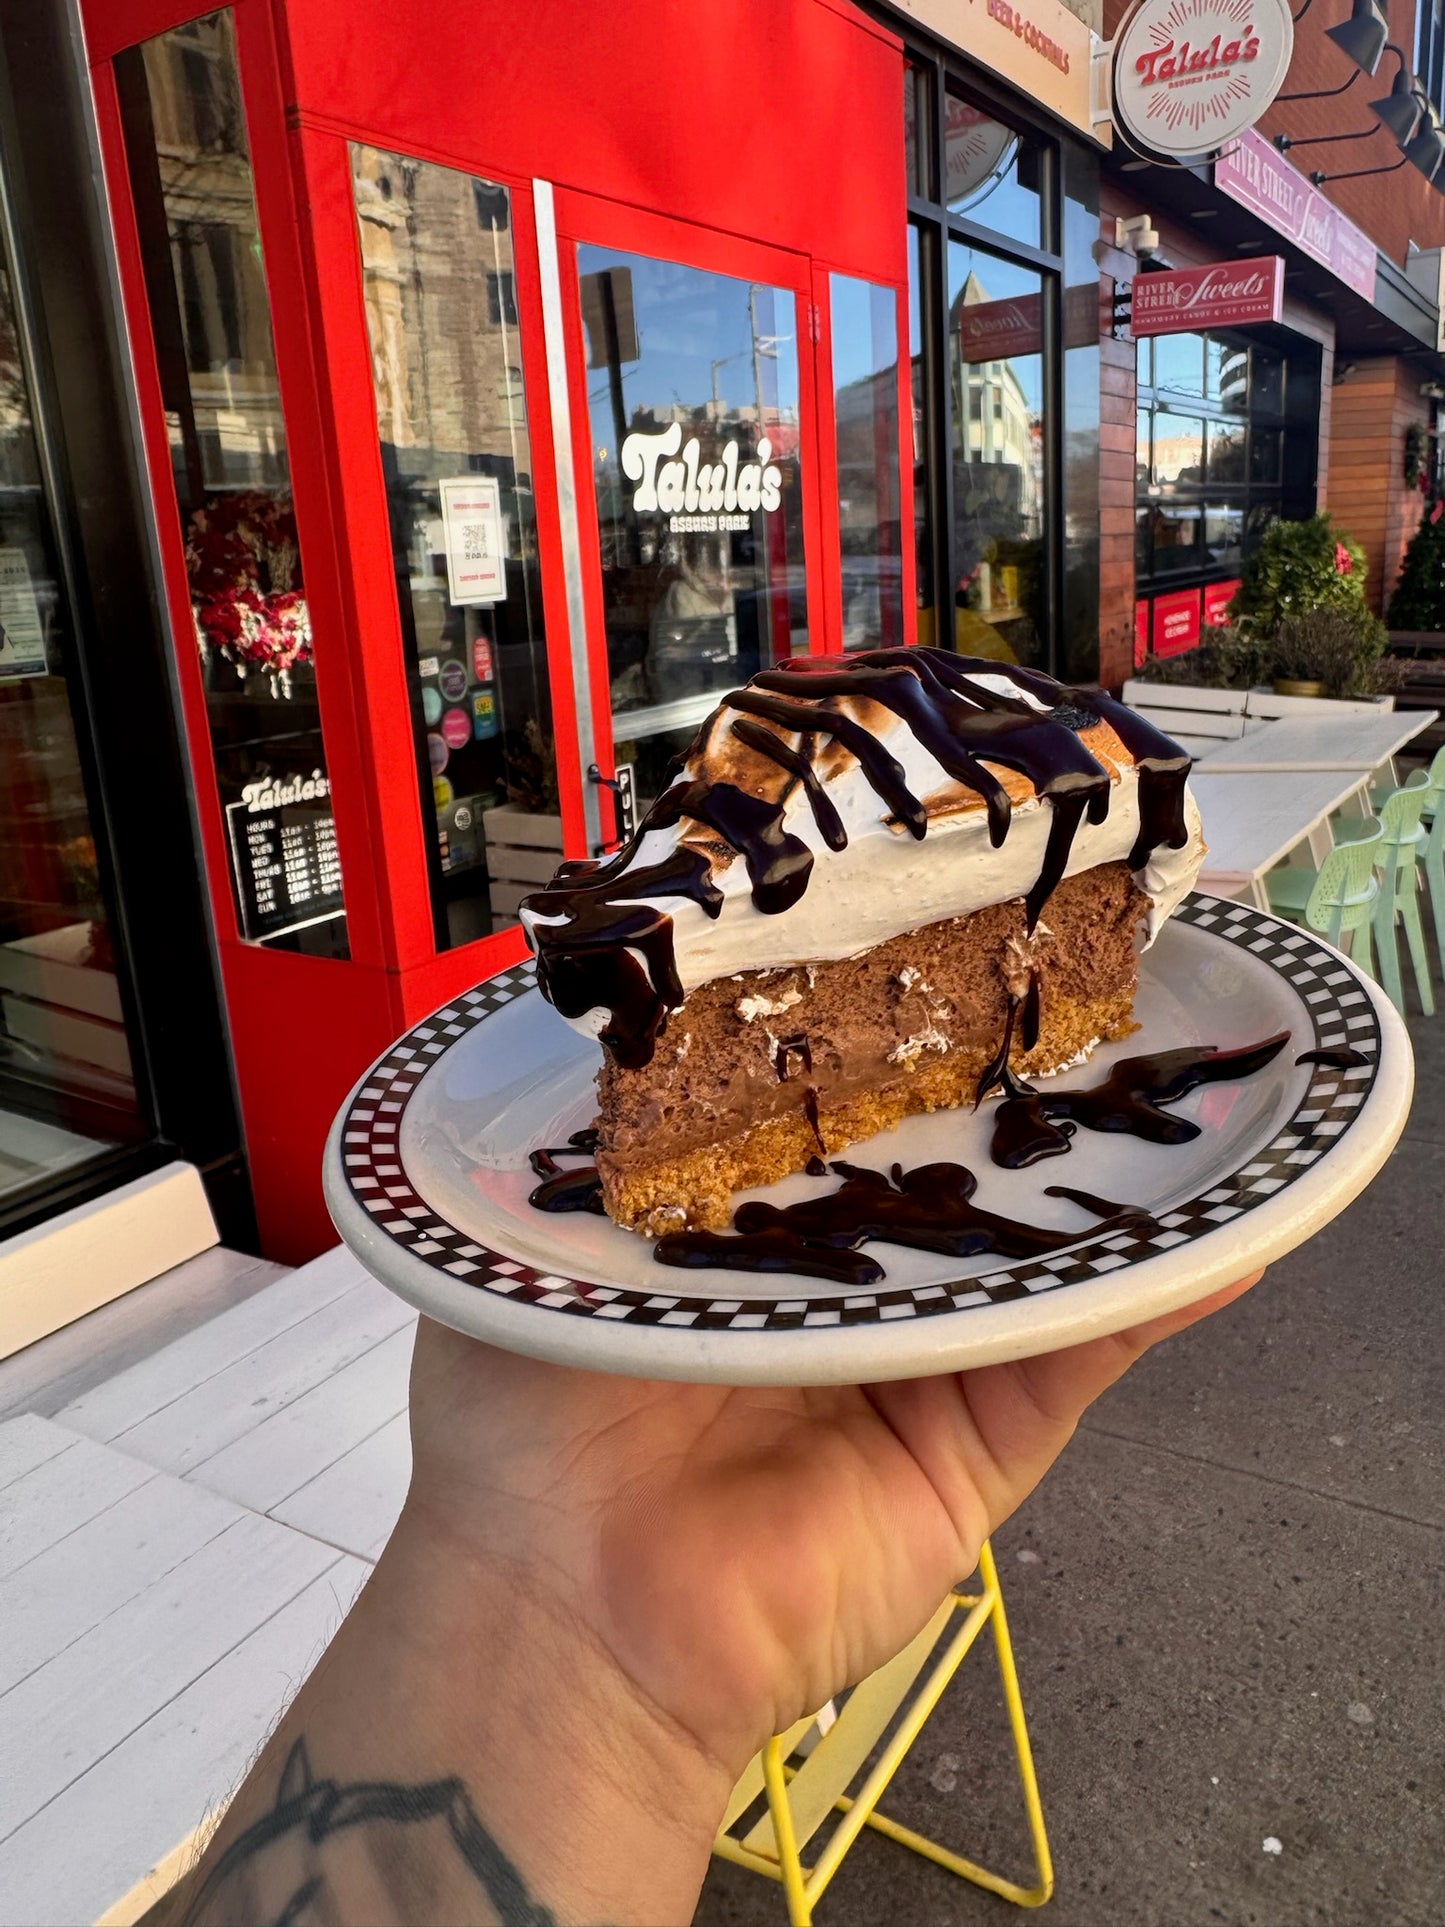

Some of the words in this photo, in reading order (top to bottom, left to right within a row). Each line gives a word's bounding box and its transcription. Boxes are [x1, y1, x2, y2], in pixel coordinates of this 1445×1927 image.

[1014, 12, 1024, 38] &
[1024, 21, 1069, 75] COCKTAILS
[1135, 24, 1260, 85] Talula's
[1228, 138, 1262, 197] RIVER
[1262, 162, 1294, 216] STREET
[1137, 281, 1174, 297] RIVER
[1174, 268, 1266, 310] Sweets
[621, 421, 782, 513] Talula's
[669, 516, 717, 533] ASBURY
[718, 515, 750, 531] PARK
[241, 768, 327, 813] Talula's
[256, 889, 275, 903] SAT
